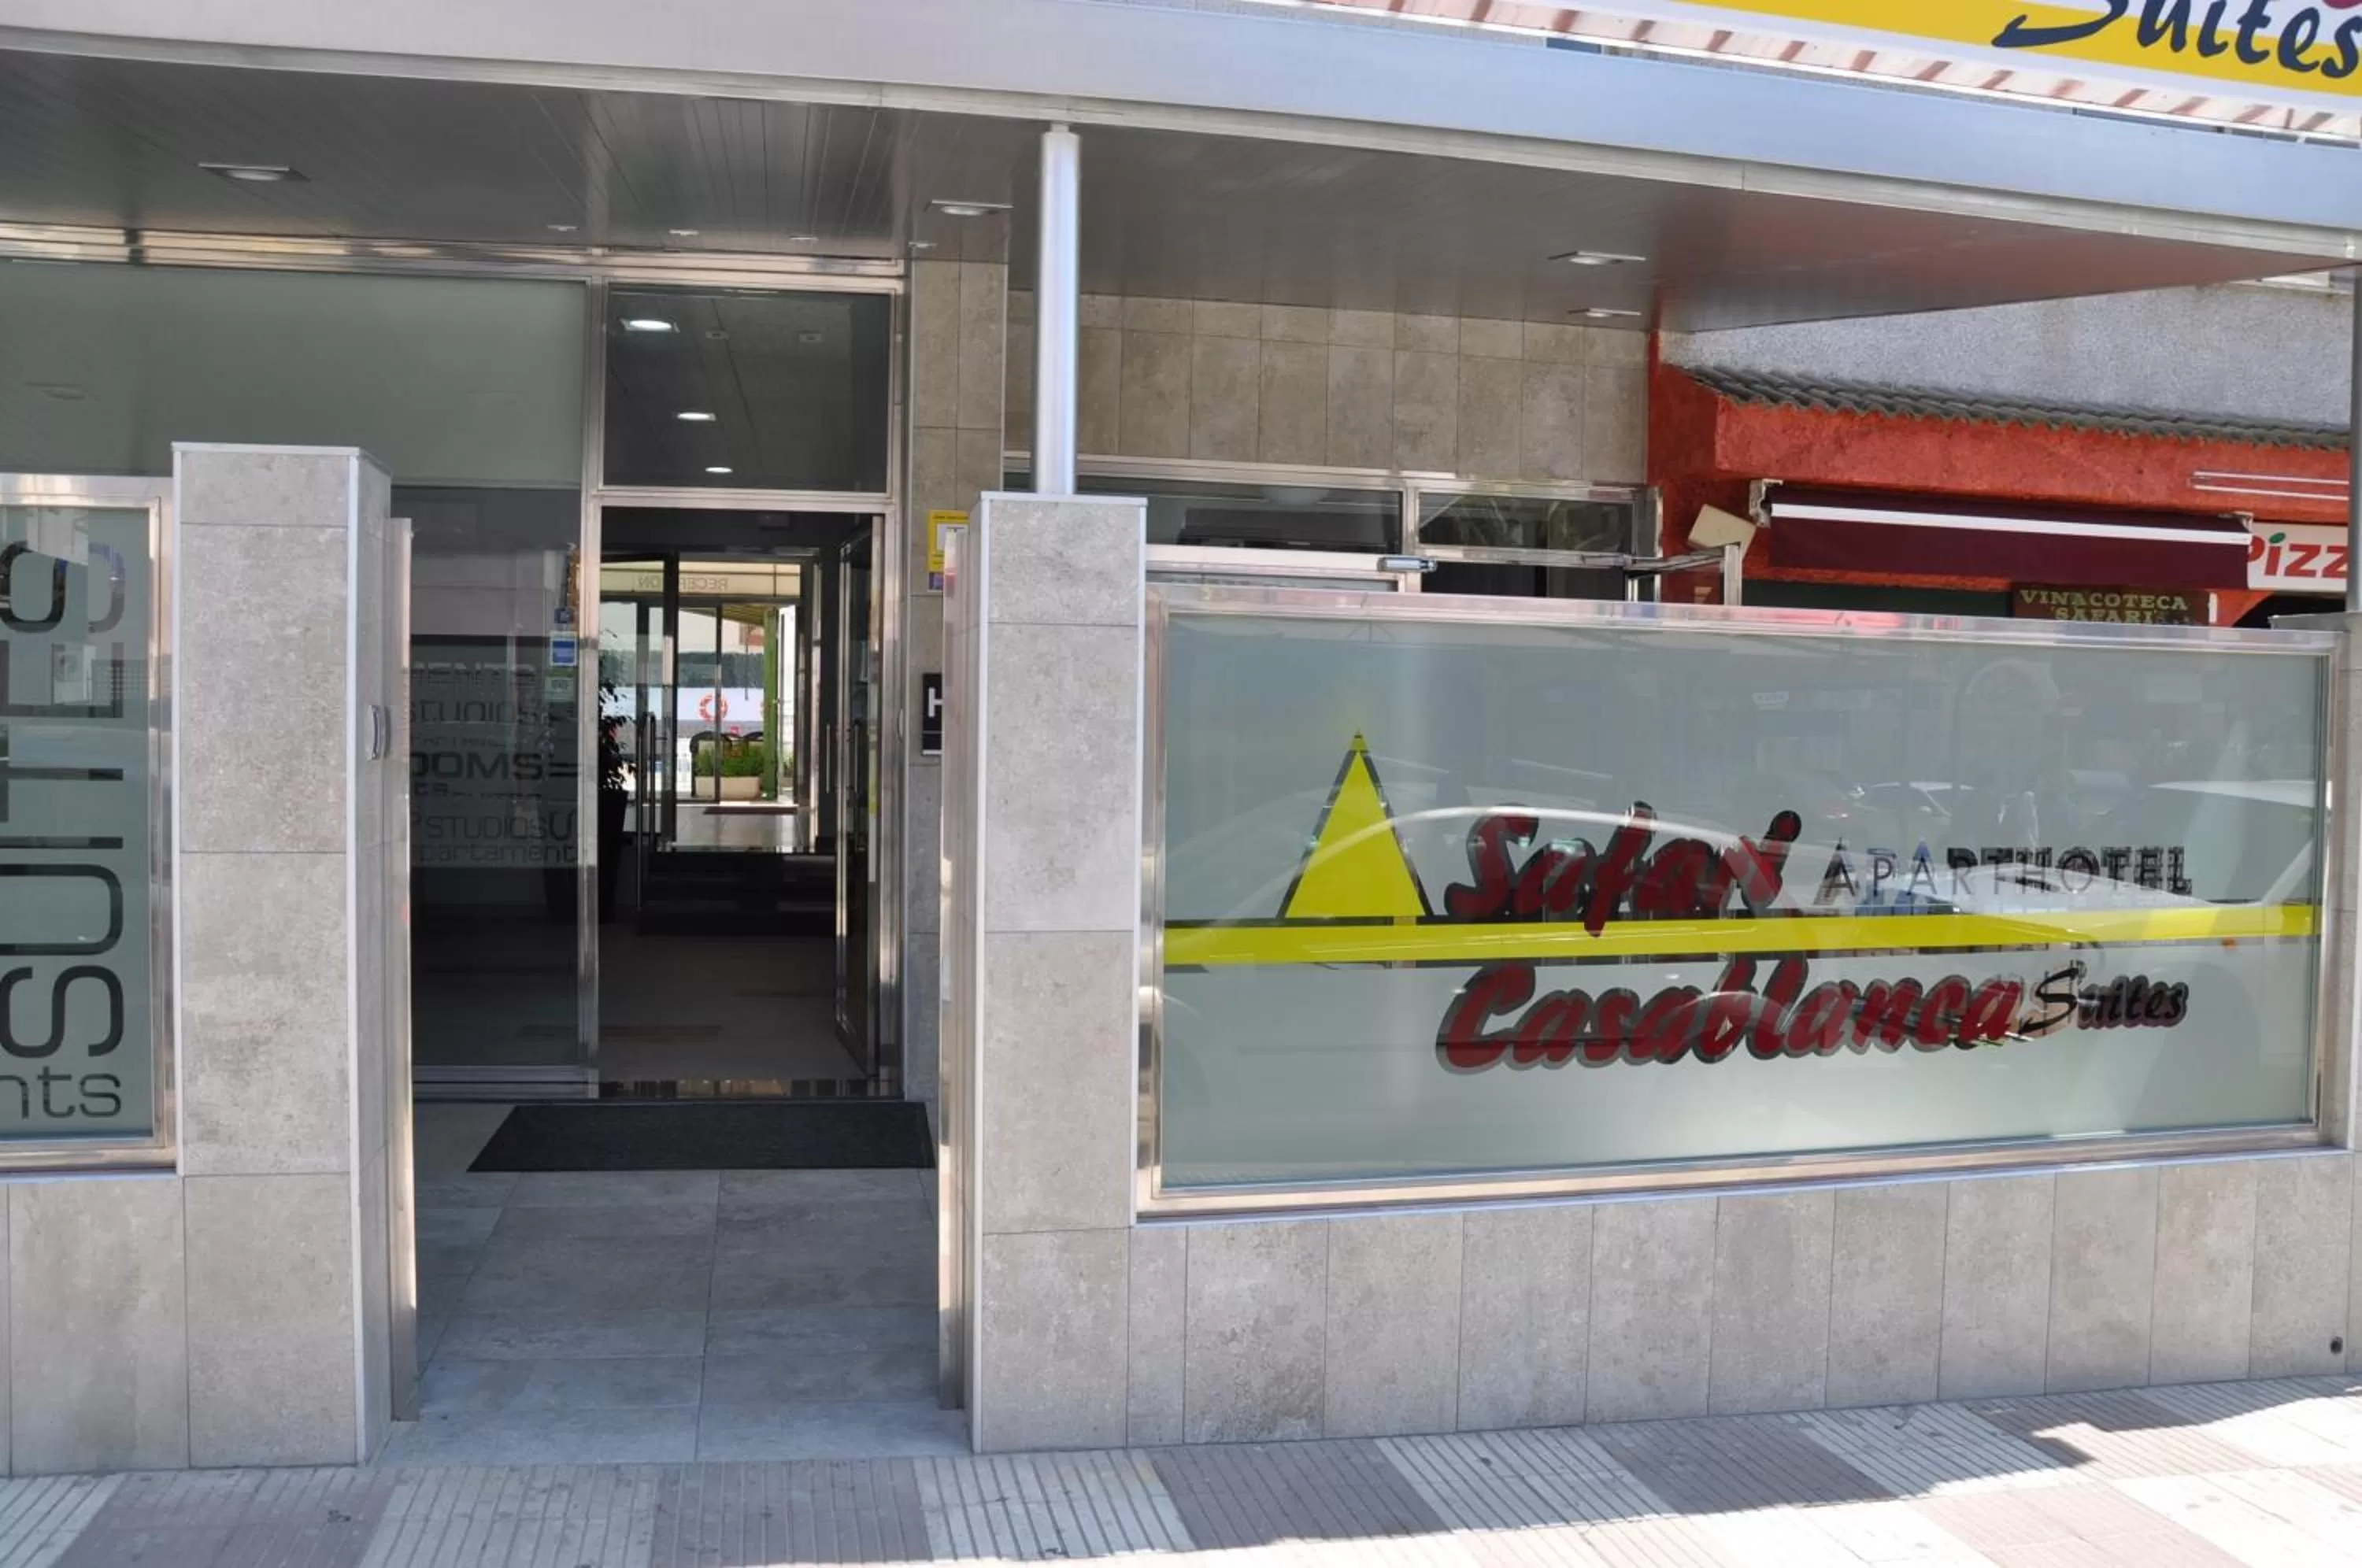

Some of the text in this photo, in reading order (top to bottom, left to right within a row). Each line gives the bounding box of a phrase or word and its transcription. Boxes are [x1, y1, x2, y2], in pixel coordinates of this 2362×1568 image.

[2020, 589, 2189, 611] VINACOTECA
[1444, 802, 2193, 937] Safari APARTHOTEL
[1435, 953, 2190, 1075] Casablanca Suites
